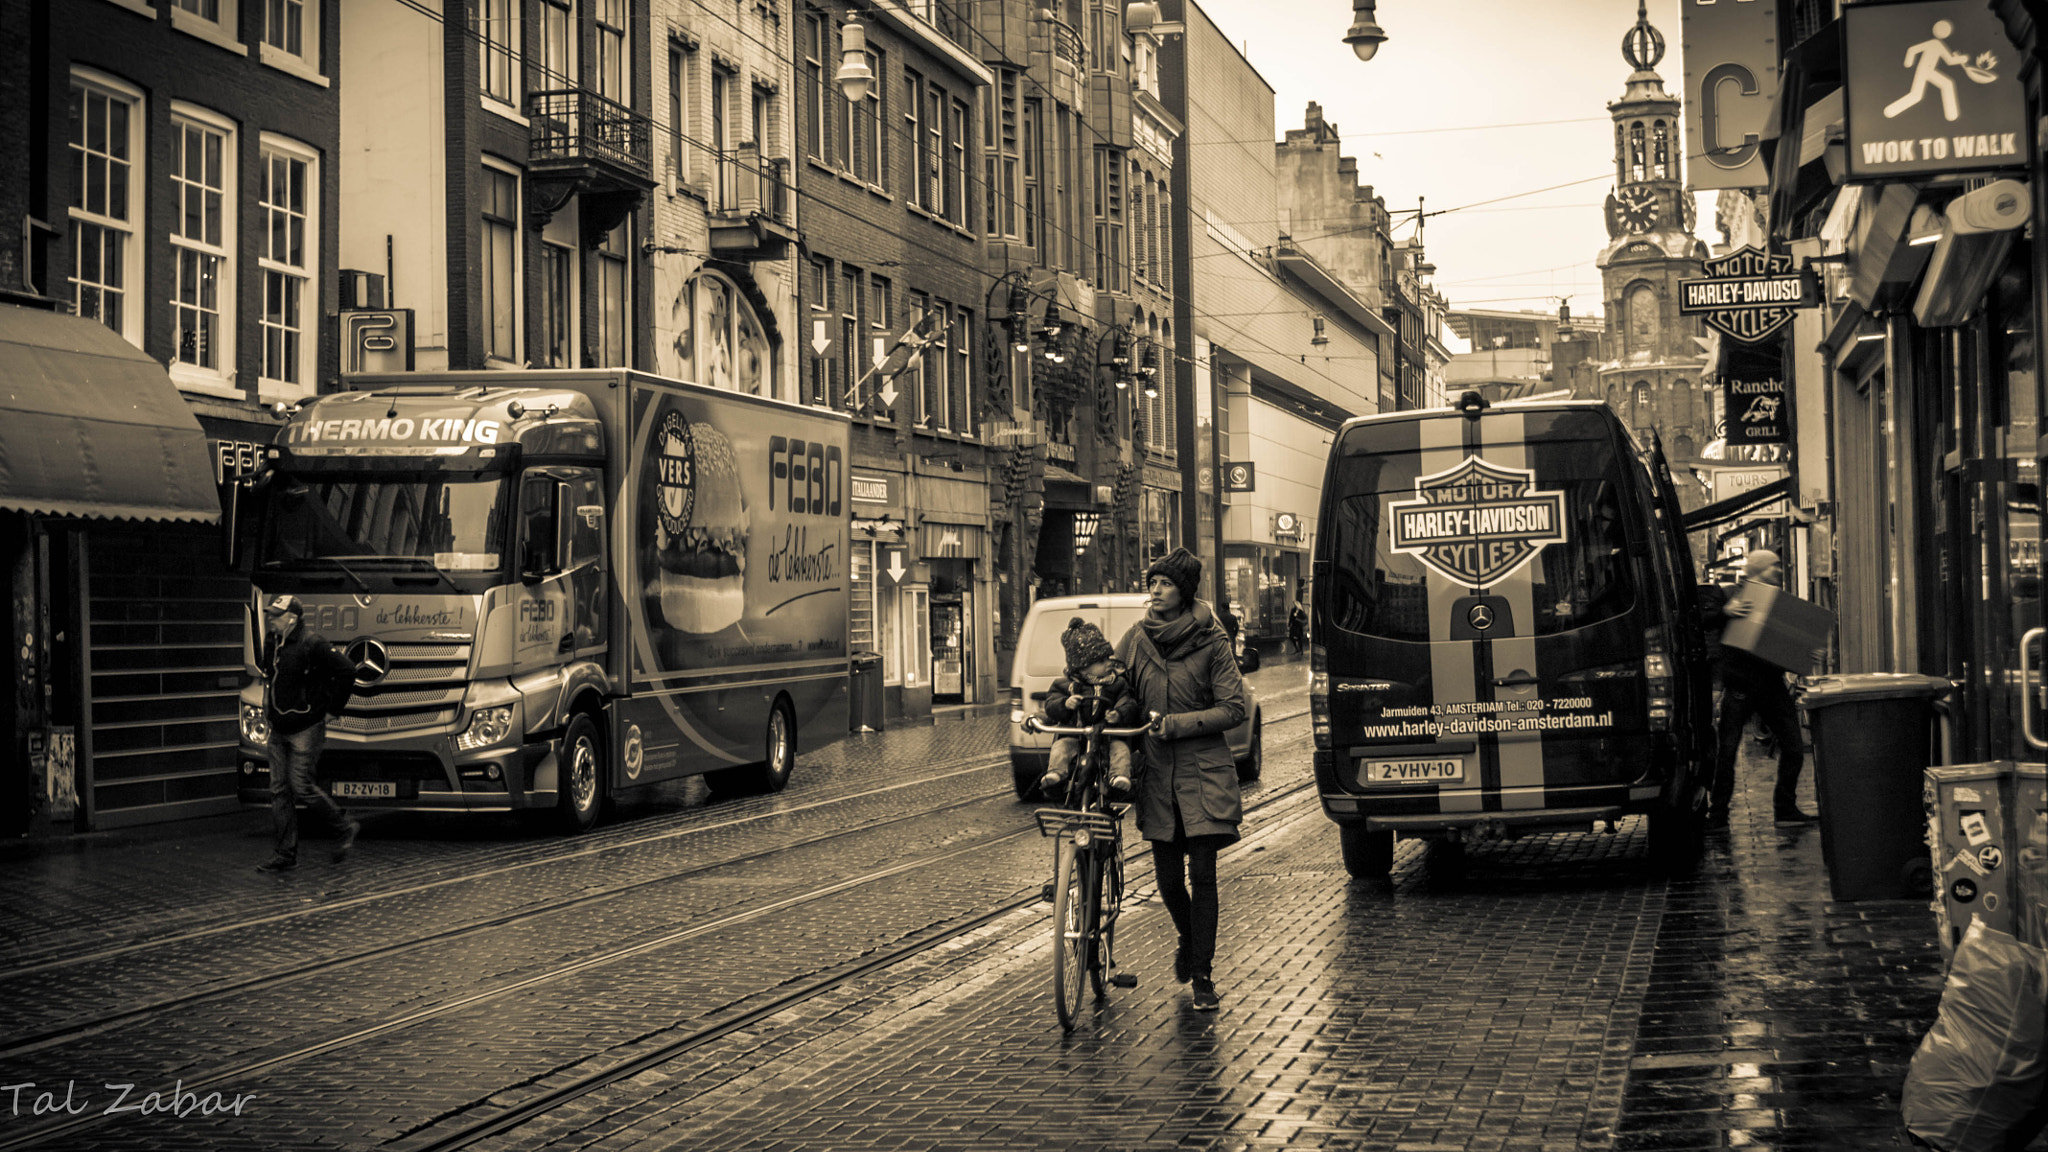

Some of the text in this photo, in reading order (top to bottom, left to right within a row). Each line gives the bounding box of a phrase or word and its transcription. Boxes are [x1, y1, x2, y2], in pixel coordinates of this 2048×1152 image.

[1862, 133, 2016, 165] WOK TO WALK
[1715, 251, 1780, 277] MOTOR
[1688, 279, 1801, 306] HARLEY-DAVIDSO
[1717, 308, 1782, 337] CYCLES
[288, 418, 500, 445] THERMO KING
[1745, 426, 1780, 438] GRILL
[658, 457, 691, 486] VERS
[768, 435, 842, 517] FEBO
[1728, 474, 1768, 487] TOURS
[1436, 472, 1514, 504] MOTOR
[1404, 505, 1550, 540] HARLEY-DAVIDSON
[1438, 541, 1516, 577] CYCLES
[302, 604, 359, 632] EBO
[376, 608, 389, 625] de
[520, 600, 554, 622] FEBO
[1380, 705, 1428, 719] Jarmuiden
[1429, 704, 1444, 717] 43,
[1446, 702, 1504, 716] AMSTERDAM
[1506, 700, 1525, 713] Tel.:
[1526, 699, 1544, 711] 020
[1552, 697, 1592, 710] 7220000
[1364, 711, 1614, 739] www.harley-davidson-amsterdam.nl
[1382, 762, 1455, 779] 2-VHV-10
[343, 783, 390, 796] BZ-ZV-18
